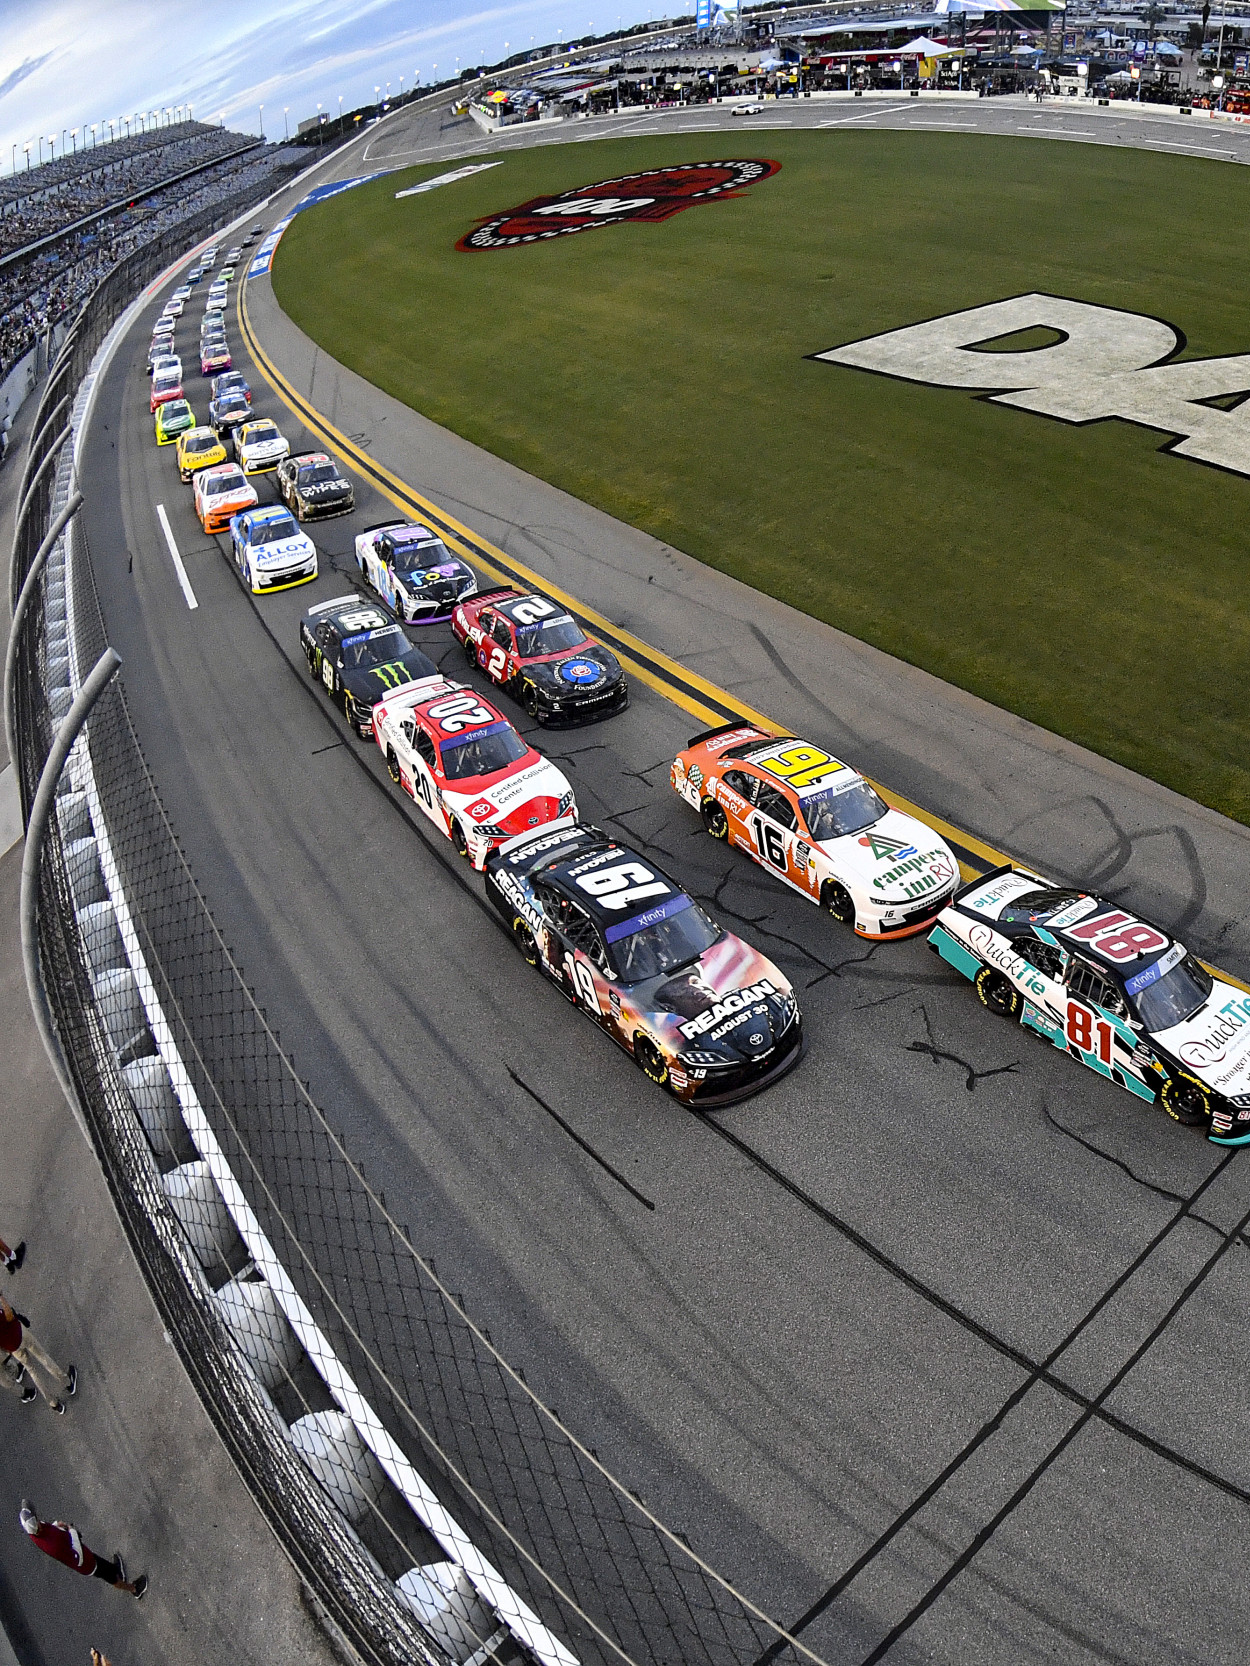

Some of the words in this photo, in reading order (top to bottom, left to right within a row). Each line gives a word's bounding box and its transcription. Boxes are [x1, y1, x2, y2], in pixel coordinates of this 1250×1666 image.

[532, 197, 656, 215] 400
[256, 541, 308, 562] ALLOY
[511, 597, 556, 625] 2
[347, 635, 366, 645] xfinity
[374, 626, 397, 636] HERBST
[519, 624, 539, 634] xfinity
[322, 658, 334, 691] 98
[488, 648, 506, 680] 2
[427, 696, 495, 733] 20
[465, 729, 488, 741] xfinity
[490, 777, 523, 798] Certified
[522, 763, 553, 781] Collision
[757, 746, 847, 788] 16
[411, 764, 433, 810] 20
[498, 786, 524, 804] Center
[716, 783, 747, 810] campers
[803, 791, 828, 805] xfinity
[718, 794, 731, 810] inn
[729, 801, 743, 815] RV
[483, 839, 494, 847] 20
[509, 828, 586, 865] REAGAN
[752, 816, 787, 873] 16
[568, 849, 626, 877] REAGAN
[873, 847, 950, 890] campers
[899, 874, 937, 898] inn
[930, 857, 954, 881] RV
[495, 868, 542, 931] REAGAN
[575, 862, 672, 910] 19
[973, 877, 1028, 908] QuickTie
[638, 908, 666, 926] xfinity
[884, 910, 895, 918] 16
[1064, 911, 1167, 961] 81
[968, 924, 1046, 996] QuickTie
[564, 951, 602, 1016] 19
[1131, 969, 1156, 989] xfinity
[679, 980, 777, 1040] REAGAN
[711, 1011, 753, 1041] AUGUST
[752, 1004, 769, 1016] 30
[1067, 1002, 1111, 1065] 81
[693, 1069, 707, 1079] 19
